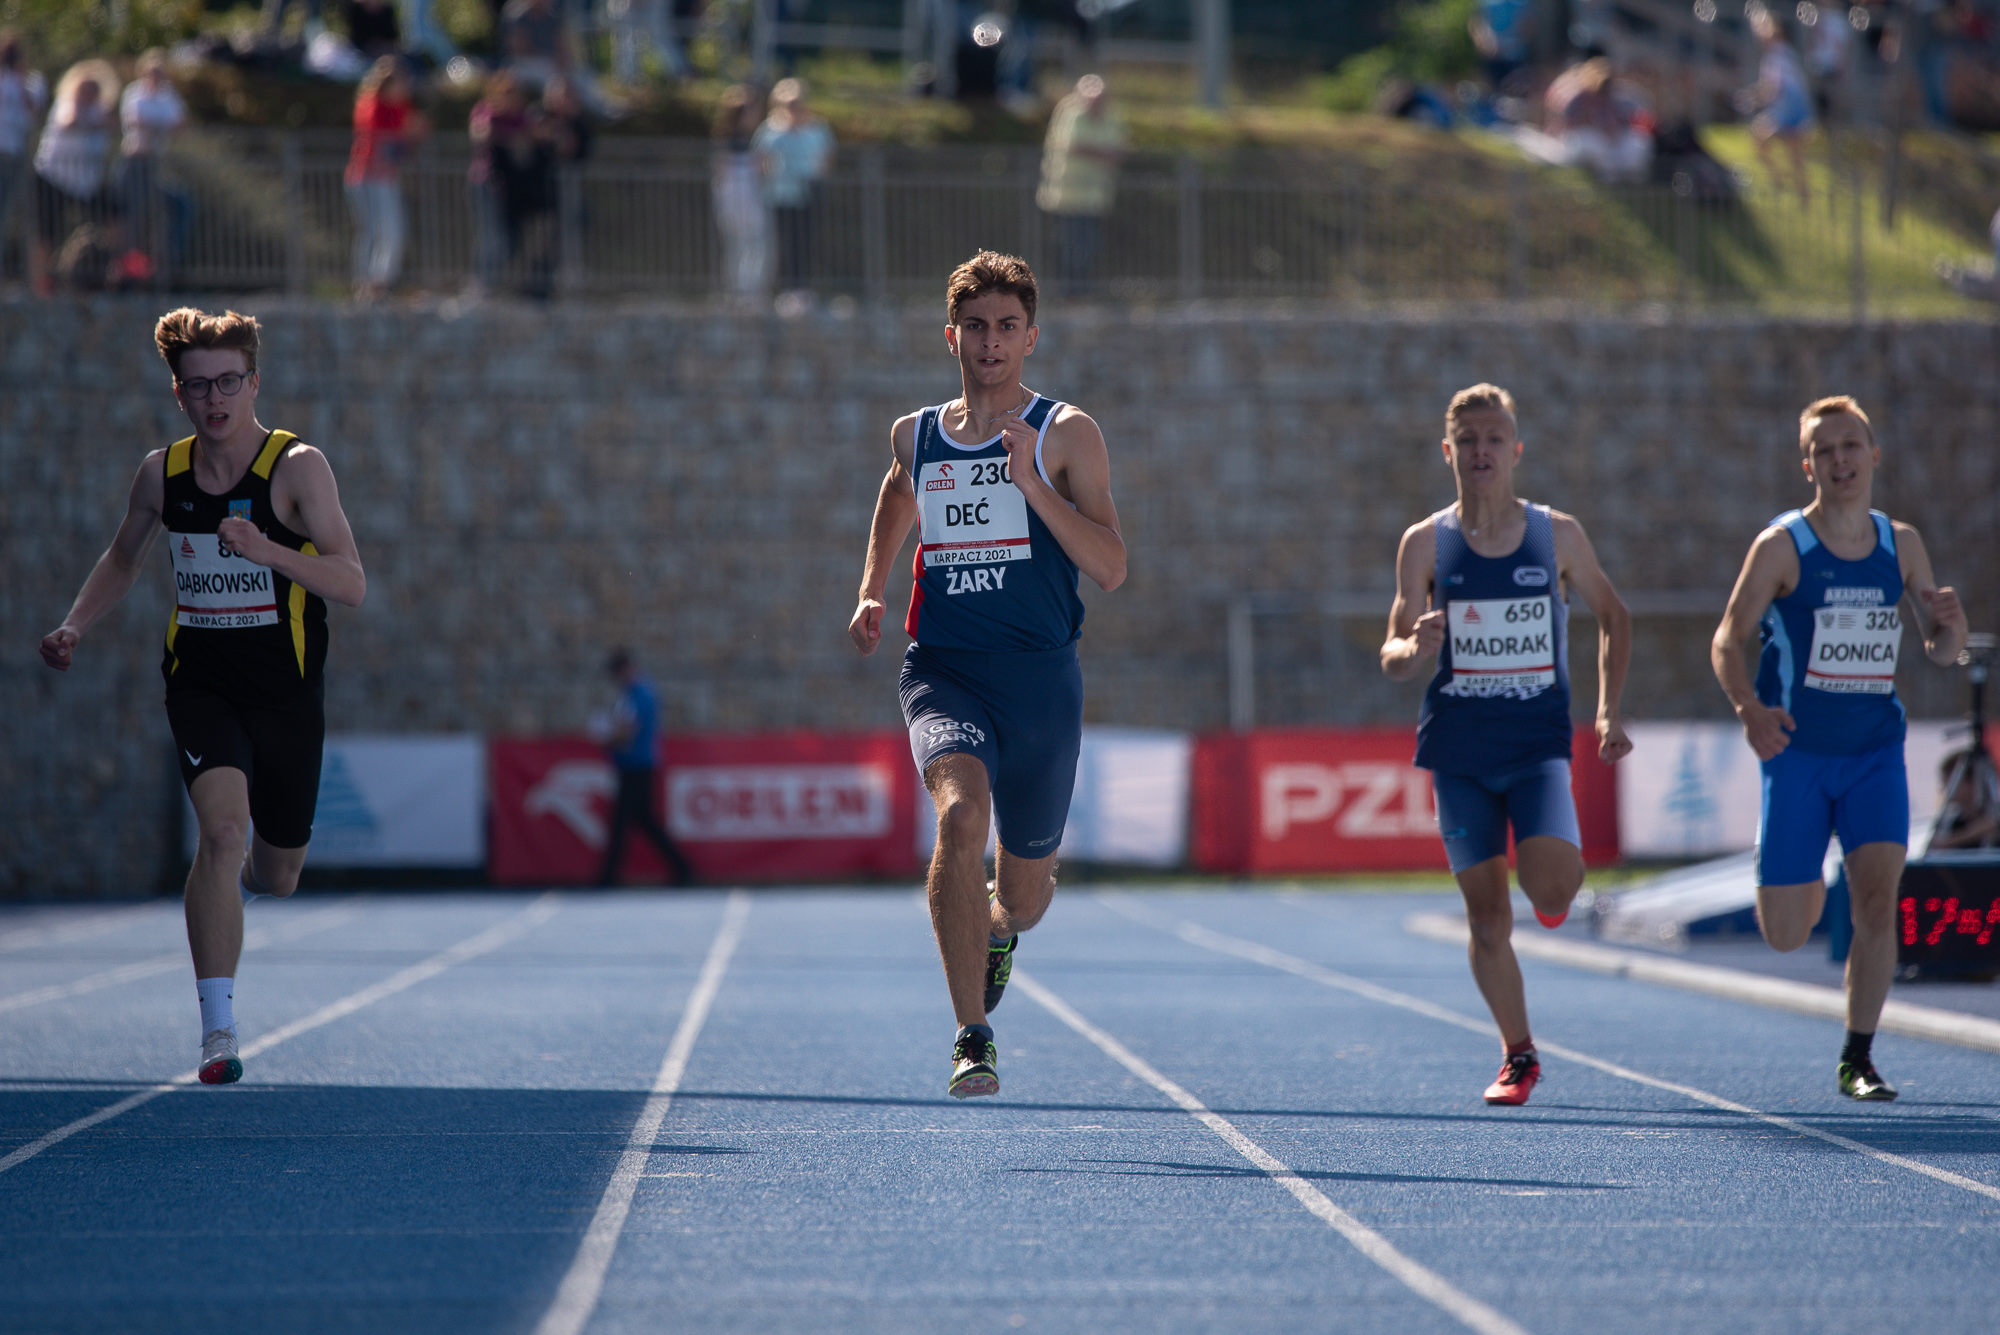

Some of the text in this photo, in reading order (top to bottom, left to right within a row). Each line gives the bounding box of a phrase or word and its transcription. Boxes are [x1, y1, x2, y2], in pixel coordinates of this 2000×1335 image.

[927, 481, 954, 491] ORLEN
[945, 497, 990, 527] DEĆ
[934, 549, 1012, 564] KARPACZ 2021
[176, 571, 268, 597] DĄBKOWSKI
[946, 566, 1007, 595] ŻARY
[189, 614, 261, 626] KARPACZ 2021
[1505, 602, 1545, 623] 650
[1865, 612, 1898, 630] 320
[1454, 634, 1548, 656] MADRAK
[1819, 643, 1894, 661] DONICA
[919, 721, 985, 744] AGROS
